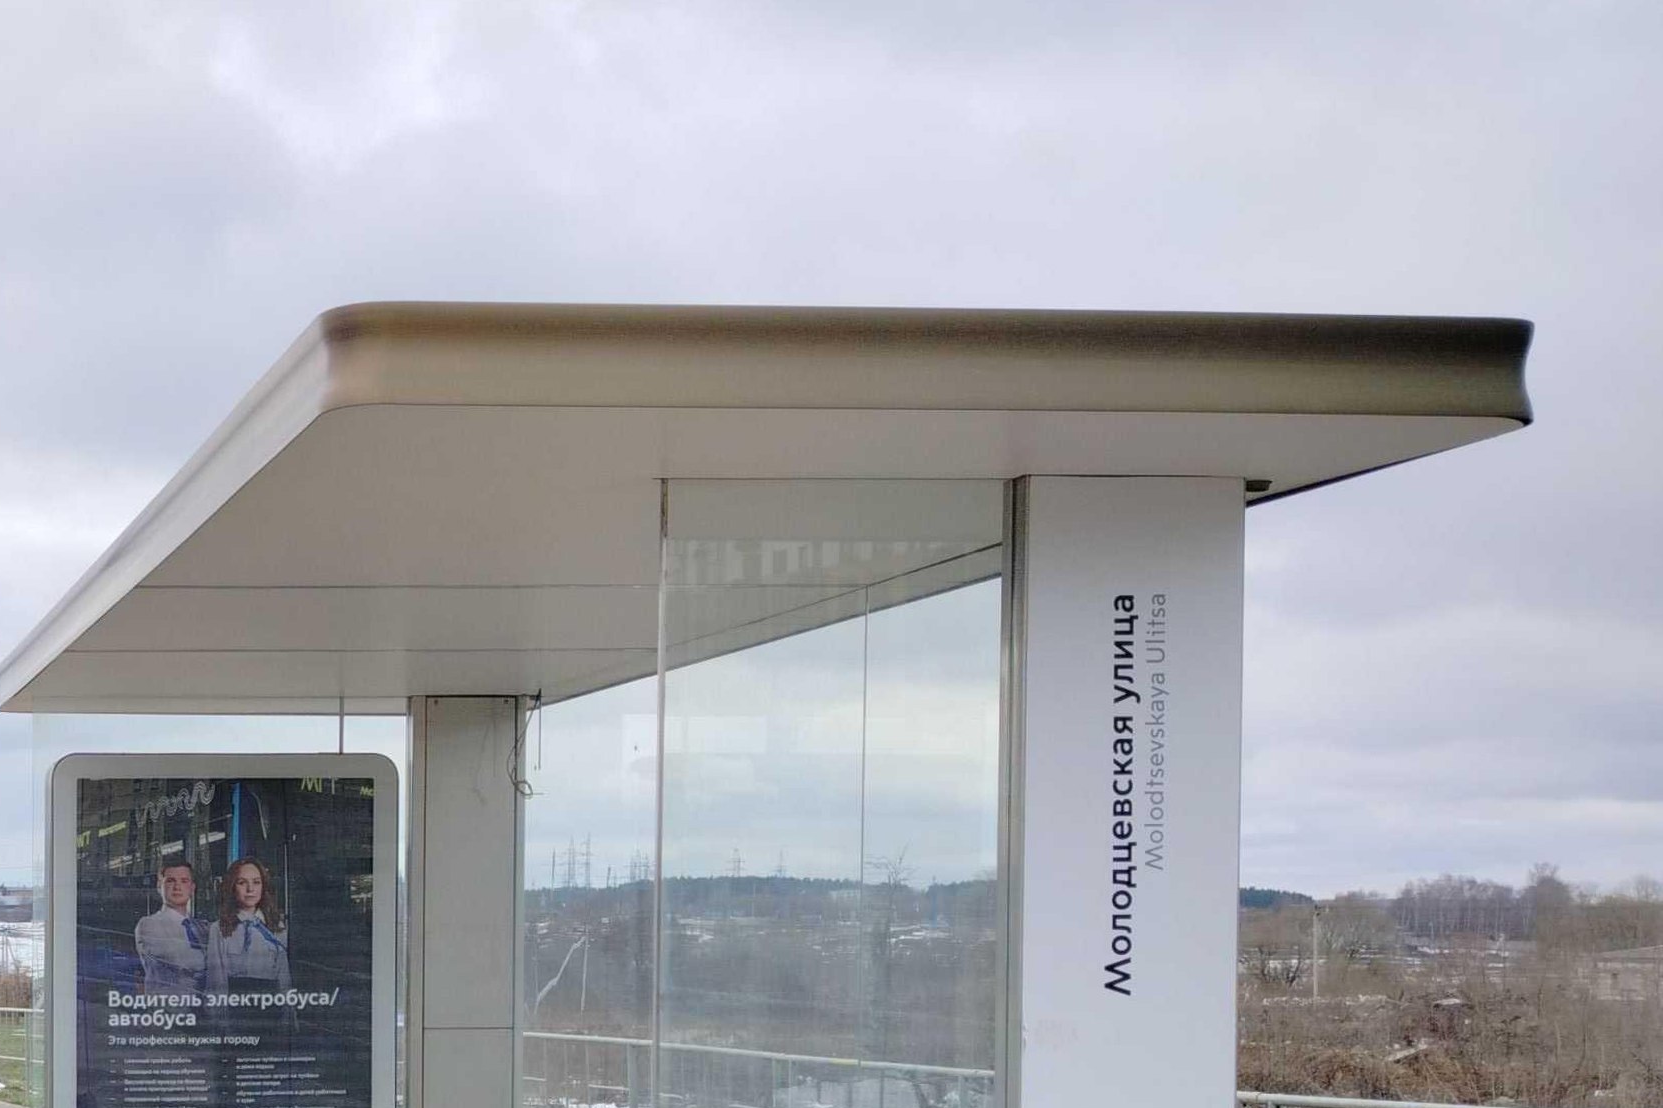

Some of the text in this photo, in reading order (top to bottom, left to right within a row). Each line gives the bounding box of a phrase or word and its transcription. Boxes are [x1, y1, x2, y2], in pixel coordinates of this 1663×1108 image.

[1144, 592, 1170, 871] Molodtsevskaya Ulitsa
[1104, 593, 1141, 996] Молодцевская улица
[108, 987, 340, 1010] Водитель электробуса/
[108, 1010, 197, 1030] автобуса
[108, 1034, 261, 1047] Эта профессия нужна городу
